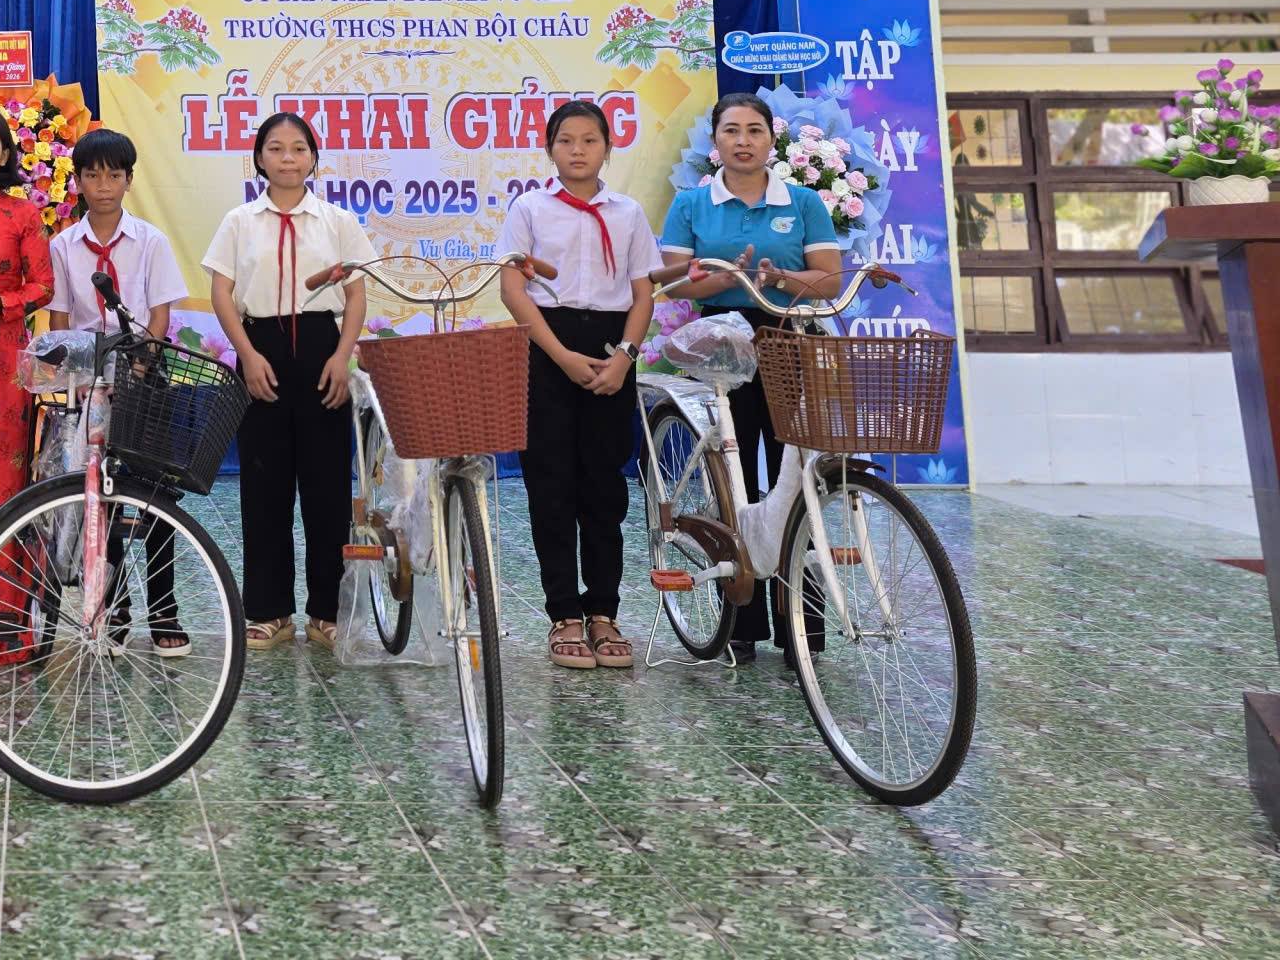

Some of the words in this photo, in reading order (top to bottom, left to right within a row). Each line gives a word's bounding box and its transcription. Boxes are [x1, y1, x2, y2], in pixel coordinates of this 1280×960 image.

[224, 12, 327, 38] TRƯỜNG
[332, 19, 395, 38] THCS
[402, 18, 468, 37] PHAN
[475, 12, 517, 42] BỘI
[524, 12, 590, 37] CHÂU
[750, 43, 769, 51] VNPT
[771, 41, 797, 51] QUẢNG
[799, 42, 816, 50] NAM
[836, 28, 901, 90] TẬP
[187, 75, 258, 151] LỄ
[279, 98, 430, 151] KHAI
[450, 82, 637, 150] GIẢG
[871, 118, 920, 172] ÀY
[327, 179, 393, 224] HỌC
[404, 179, 478, 214] 2025
[488, 196, 496, 205] -
[420, 239, 441, 258] Vu
[444, 239, 476, 261] Gia,
